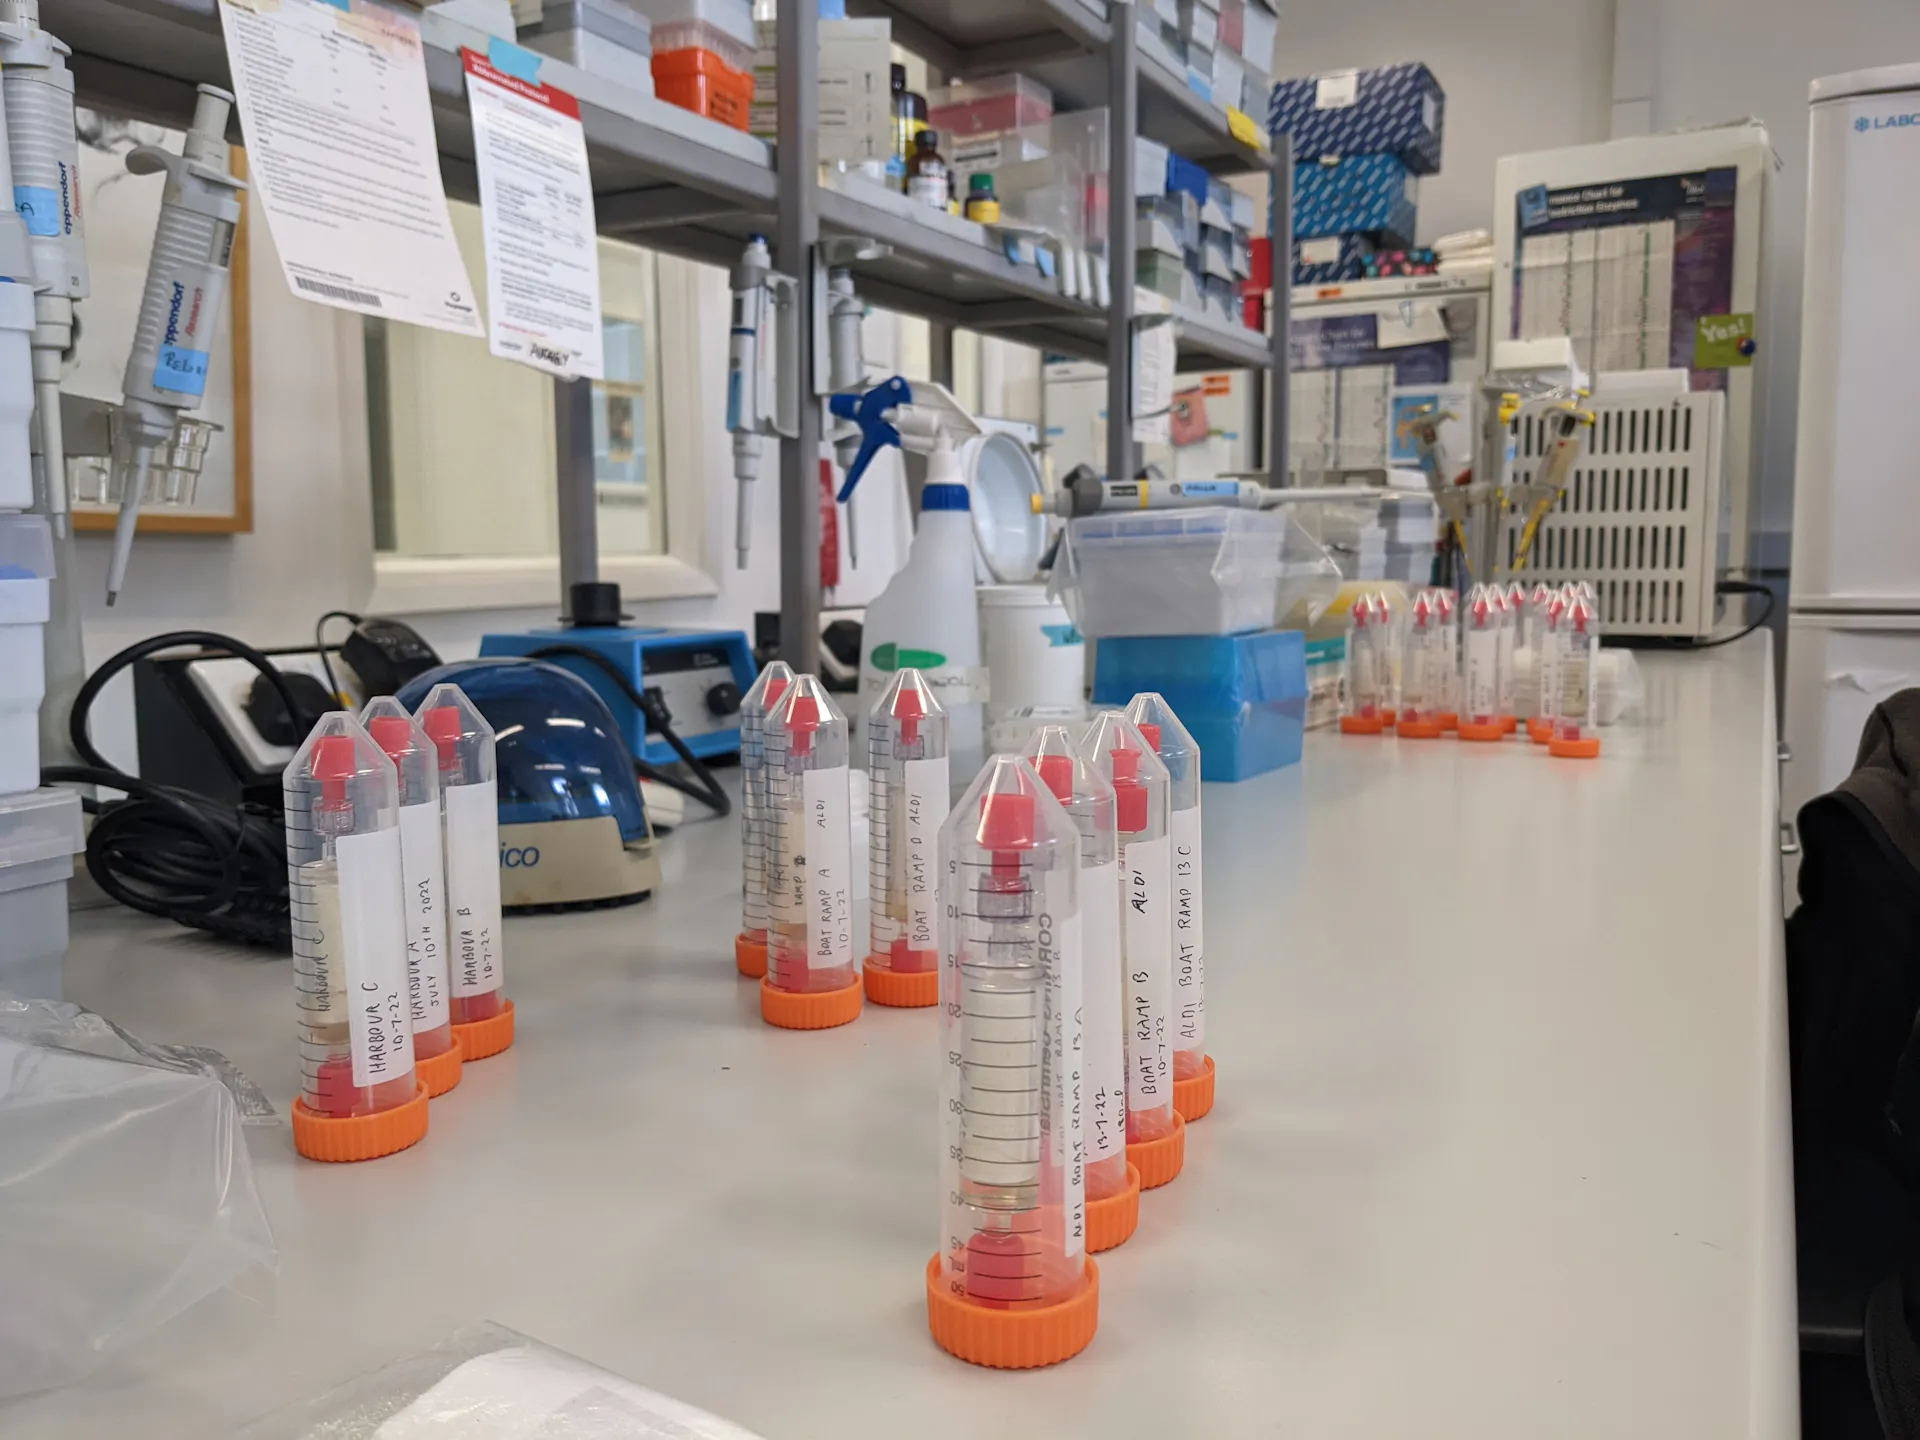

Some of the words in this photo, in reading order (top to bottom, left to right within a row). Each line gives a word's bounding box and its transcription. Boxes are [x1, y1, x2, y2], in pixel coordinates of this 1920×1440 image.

[58, 161, 73, 235] eppendorf
[816, 800, 826, 828] ALDI
[909, 794, 922, 825] ALDI
[949, 860, 957, 874] 5
[1177, 845, 1191, 856] C
[818, 868, 830, 878] A
[912, 853, 927, 893] RAMP
[1178, 861, 1191, 876] 13
[417, 877, 433, 914] 2022
[818, 889, 832, 923] RAMP
[1131, 870, 1146, 913] ALDI
[456, 907, 472, 917] B
[836, 888, 849, 949] 10-7-22
[947, 904, 960, 919] 10
[1177, 888, 1192, 929] RAMP
[912, 909, 930, 942] BOAT
[422, 926, 437, 959] 10TH
[461, 929, 478, 986] HARBOUR
[480, 927, 493, 979] 10-7-22
[817, 929, 833, 956] BOAT
[947, 954, 960, 969] 15
[1132, 971, 1149, 983] B
[1179, 943, 1194, 987] BOAT
[361, 982, 379, 992] C
[427, 975, 440, 1007] JULY
[387, 991, 404, 1052] 10-7-22
[948, 1002, 961, 1019] 20
[1137, 996, 1151, 1040] RAMP
[1180, 1002, 1196, 1039] ALDI
[365, 1002, 387, 1074] HARBOUR
[1072, 1033, 1082, 1051] 13
[1155, 1015, 1167, 1077] 10-7-22
[948, 1051, 962, 1067] 25
[1141, 1056, 1157, 1094] BOAT
[949, 1098, 964, 1115] 30
[1072, 1071, 1081, 1129] RAMP
[1095, 1086, 1109, 1150] 13-7-22
[949, 1145, 964, 1163] 35
[1072, 1141, 1083, 1186] BOAT
